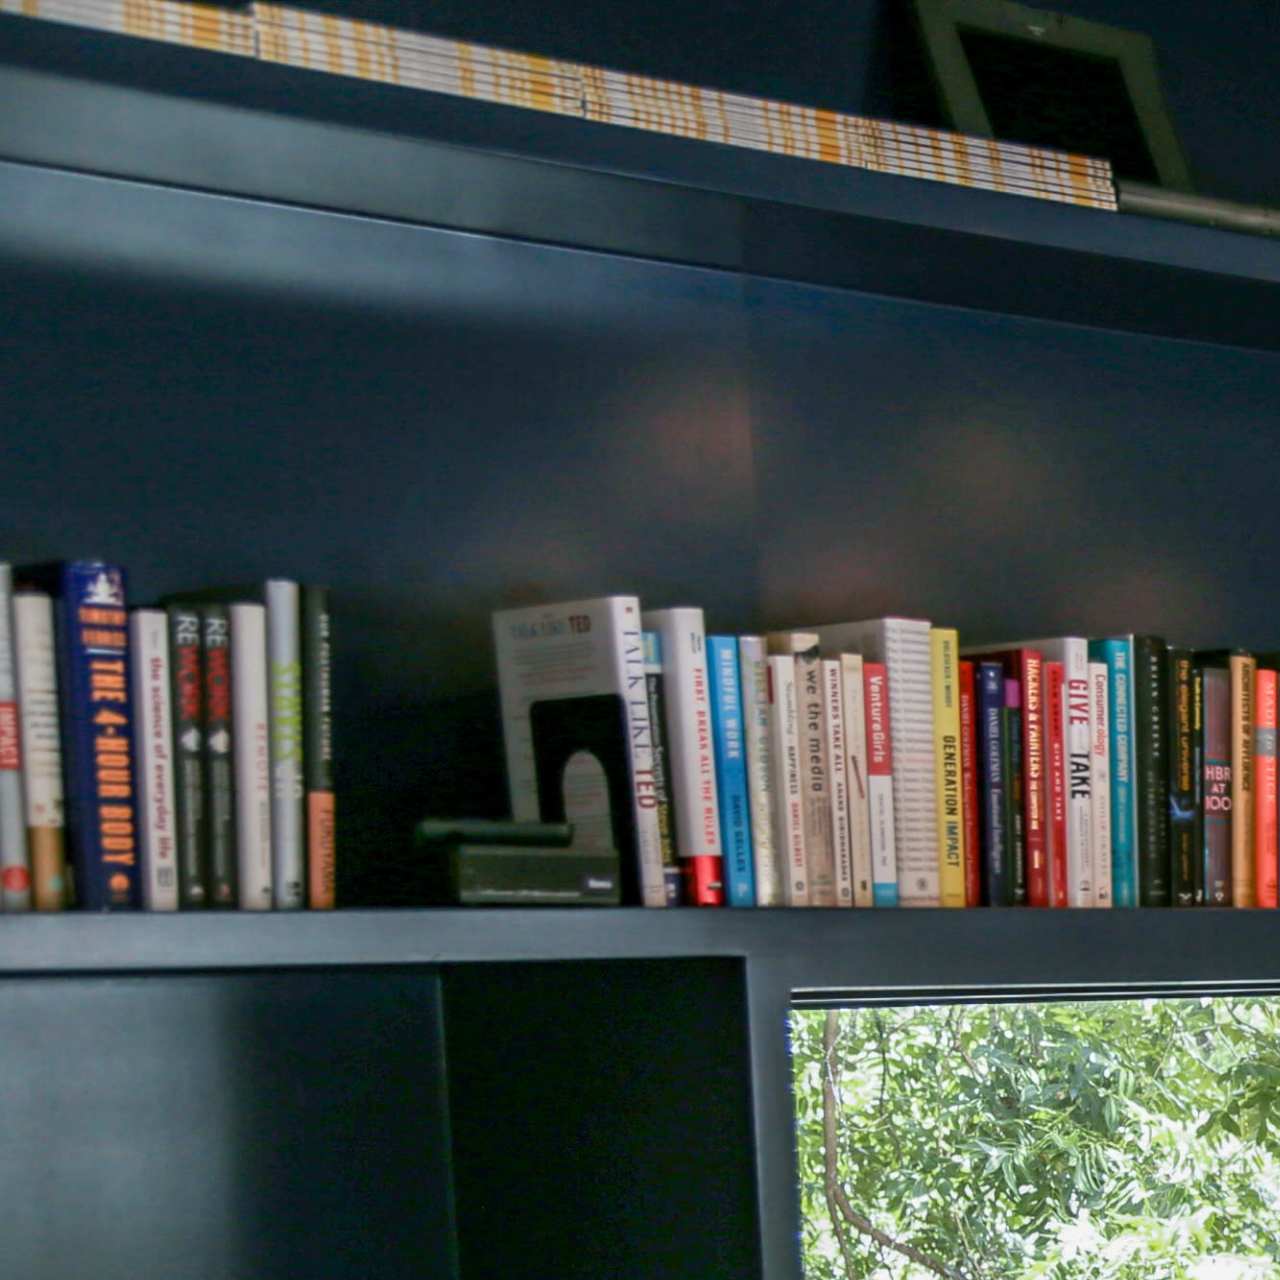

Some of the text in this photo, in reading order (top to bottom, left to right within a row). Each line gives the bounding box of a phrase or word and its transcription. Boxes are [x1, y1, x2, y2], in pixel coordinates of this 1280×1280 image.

[90, 660, 127, 703] THE
[177, 615, 201, 720] REWORK
[206, 617, 230, 721] REWORK
[720, 650, 742, 759] MINDFUL WORK
[869, 676, 887, 763] VentureGirls
[1026, 659, 1042, 778] HACKERS & PAINTERS
[91, 709, 132, 798] 4-HOUR
[150, 657, 172, 858] the science of everyday life
[624, 631, 657, 810] TALK LIKE TED
[788, 746, 799, 794] HAPPINESS
[806, 671, 825, 792] we the media
[830, 668, 843, 773] WINNERS TAKE ALL
[1068, 679, 1092, 799] GIVE TAKE
[1116, 735, 1129, 784] COMPANY
[1178, 660, 1192, 793] the elegant universe
[696, 710, 716, 845] BREAK ALL THE RULES
[732, 795, 742, 827] DAVID
[791, 802, 801, 831] DANIEL
[942, 736, 960, 867] GENERATION IMPACT
[1204, 766, 1232, 781] HBR
[1204, 796, 1232, 811] 100
[1211, 783, 1227, 795] AT
[99, 805, 135, 866] BODY
